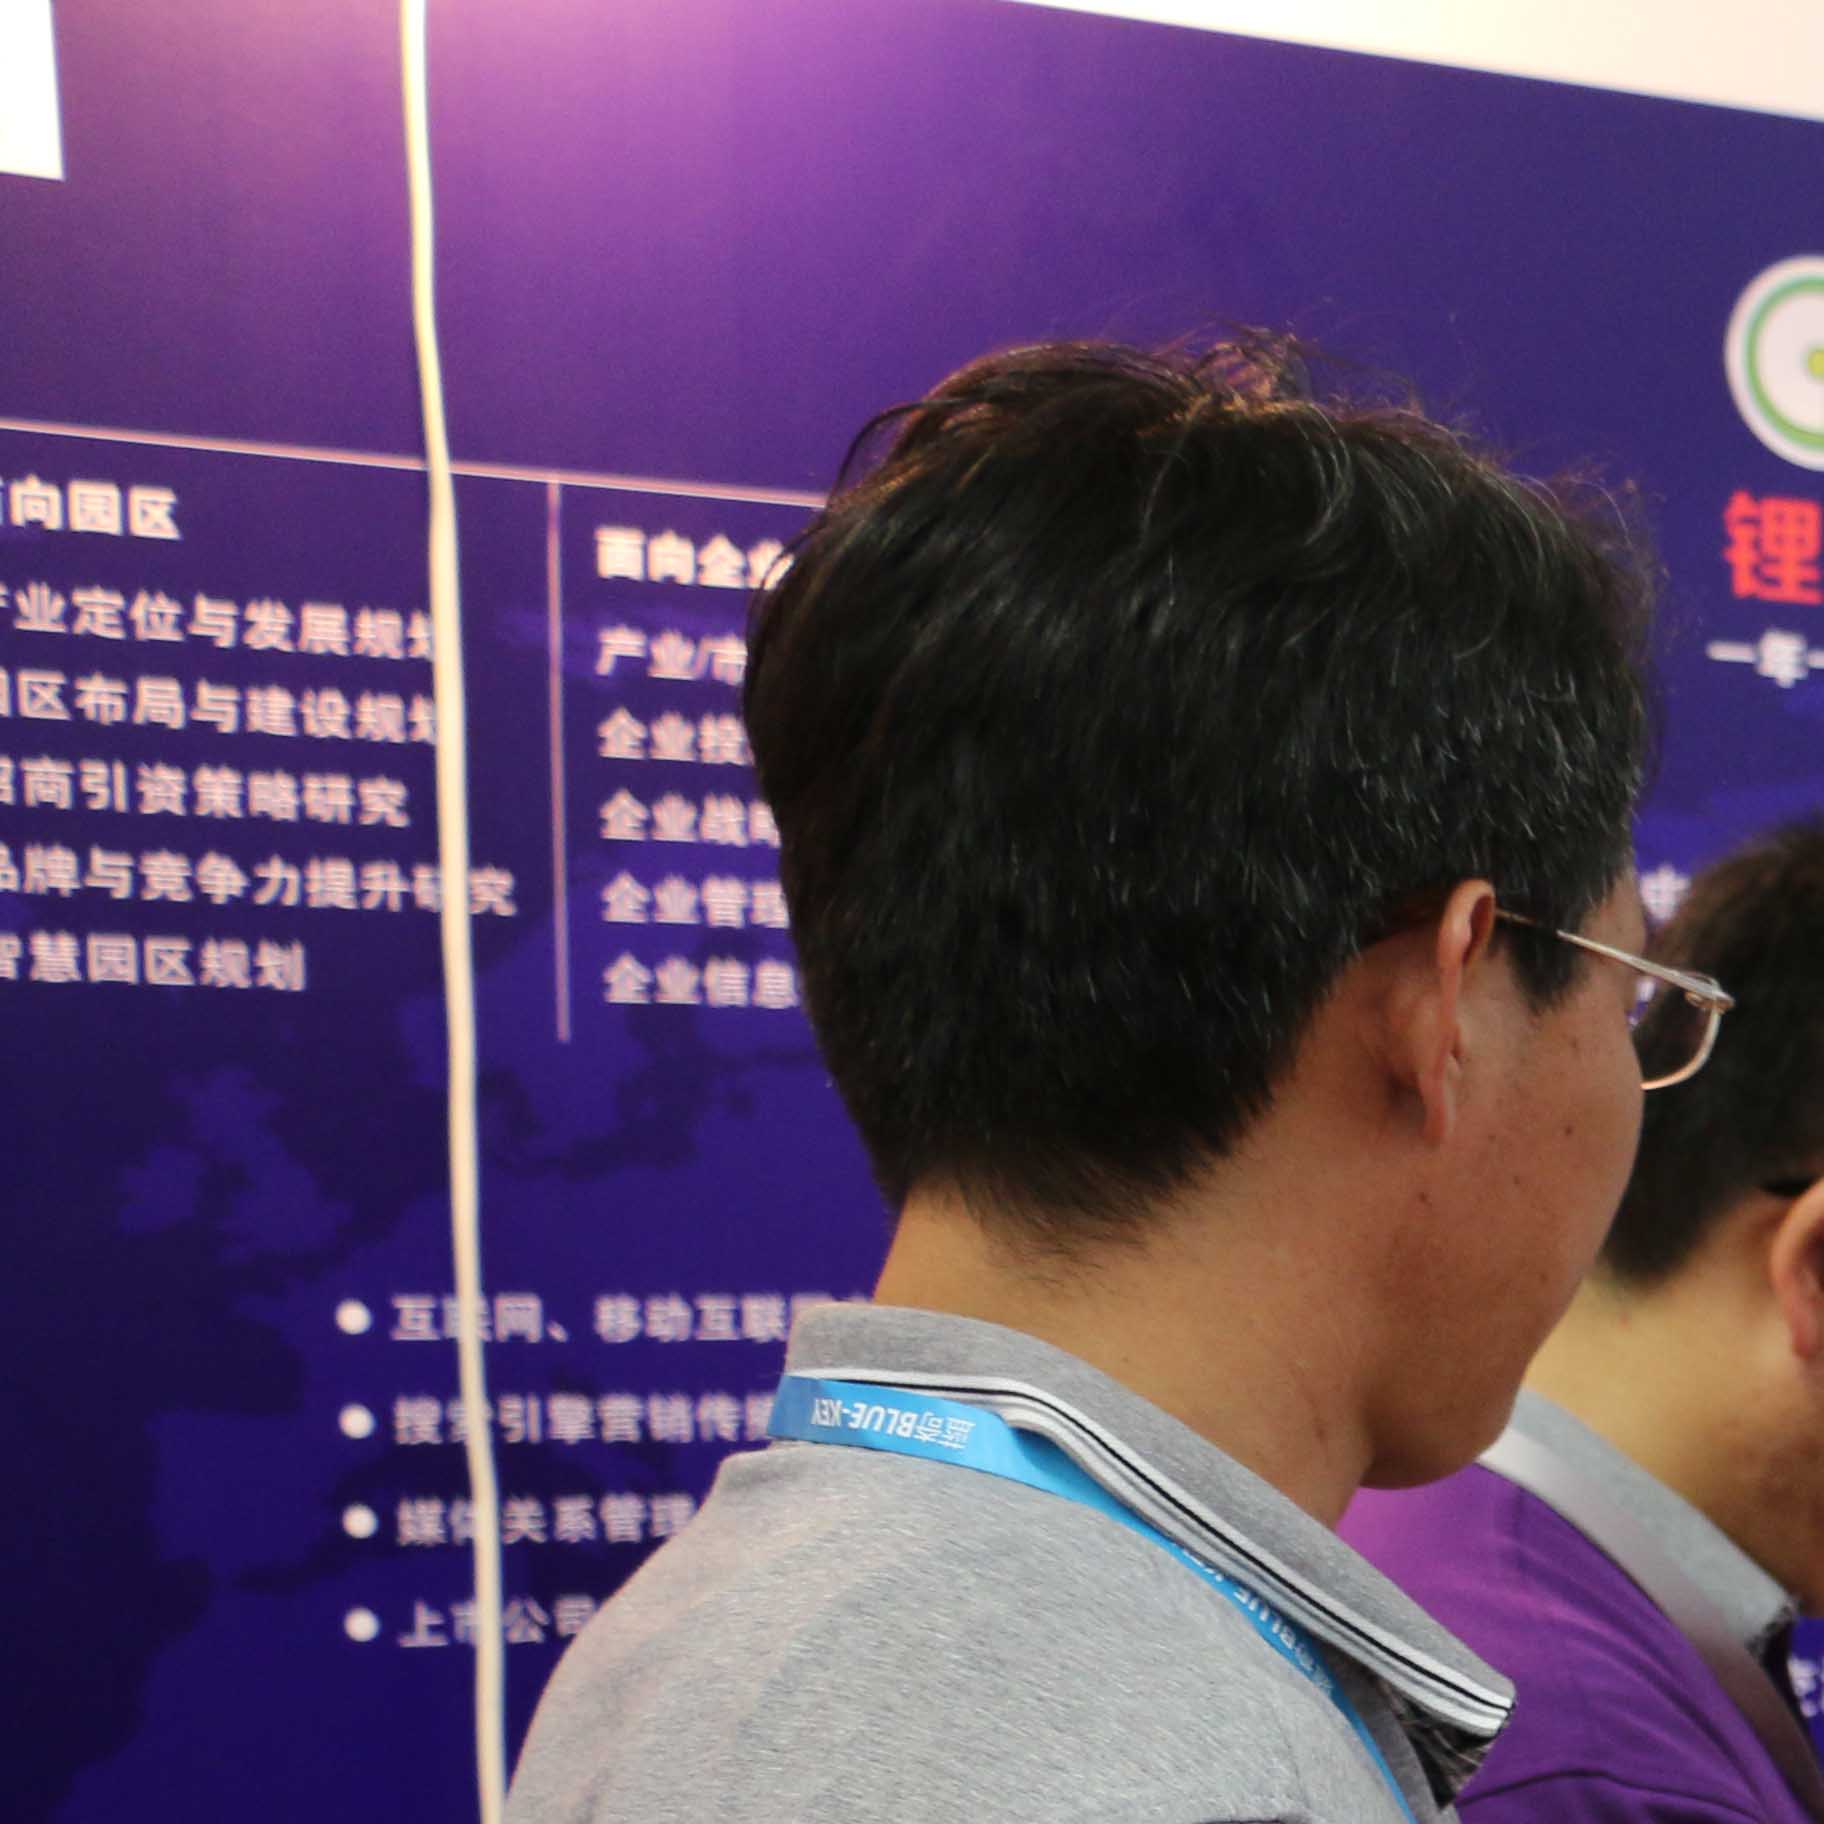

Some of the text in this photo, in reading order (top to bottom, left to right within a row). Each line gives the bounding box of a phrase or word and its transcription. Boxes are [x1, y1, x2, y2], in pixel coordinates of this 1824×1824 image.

[0, 475, 182, 541] 向园区
[0, 582, 435, 661] 业定位与发展规划
[0, 668, 438, 747] 区布局与建设规划
